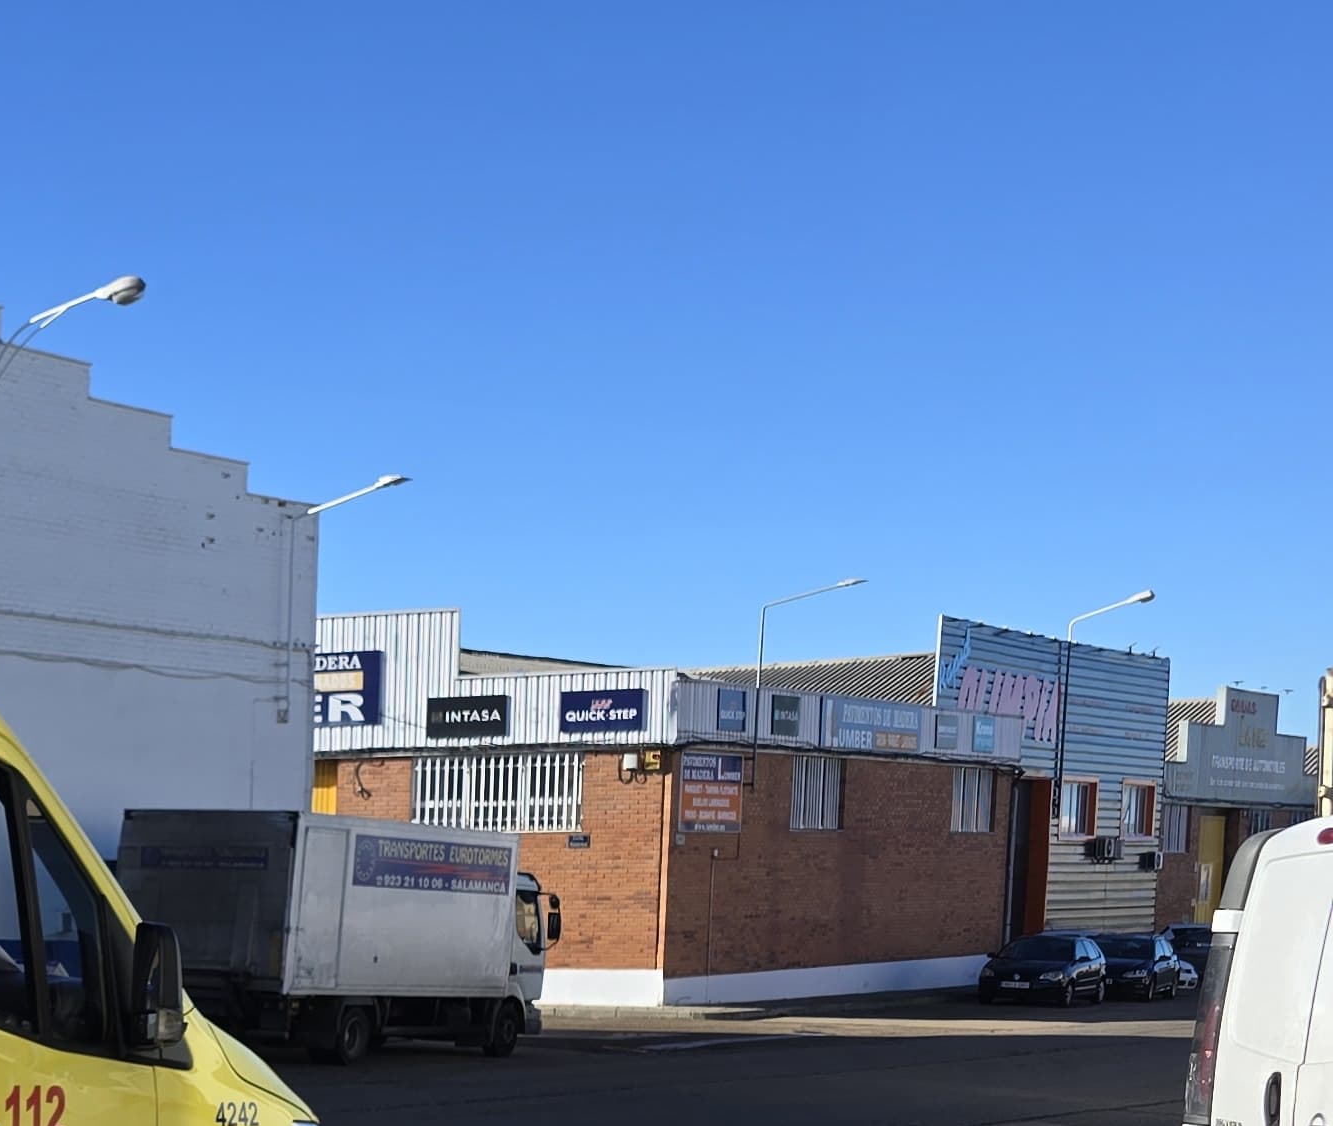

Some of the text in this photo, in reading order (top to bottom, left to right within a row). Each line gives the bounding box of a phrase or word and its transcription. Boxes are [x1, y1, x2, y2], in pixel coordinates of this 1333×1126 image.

[314, 654, 362, 671] DERA
[445, 708, 501, 723] INTASA
[378, 839, 509, 867] TRANSPORTES EUROTORMES
[384, 875, 402, 887] 923
[404, 876, 415, 887] 21
[419, 876, 429, 888] 10
[451, 879, 507, 893] SALAMANCA
